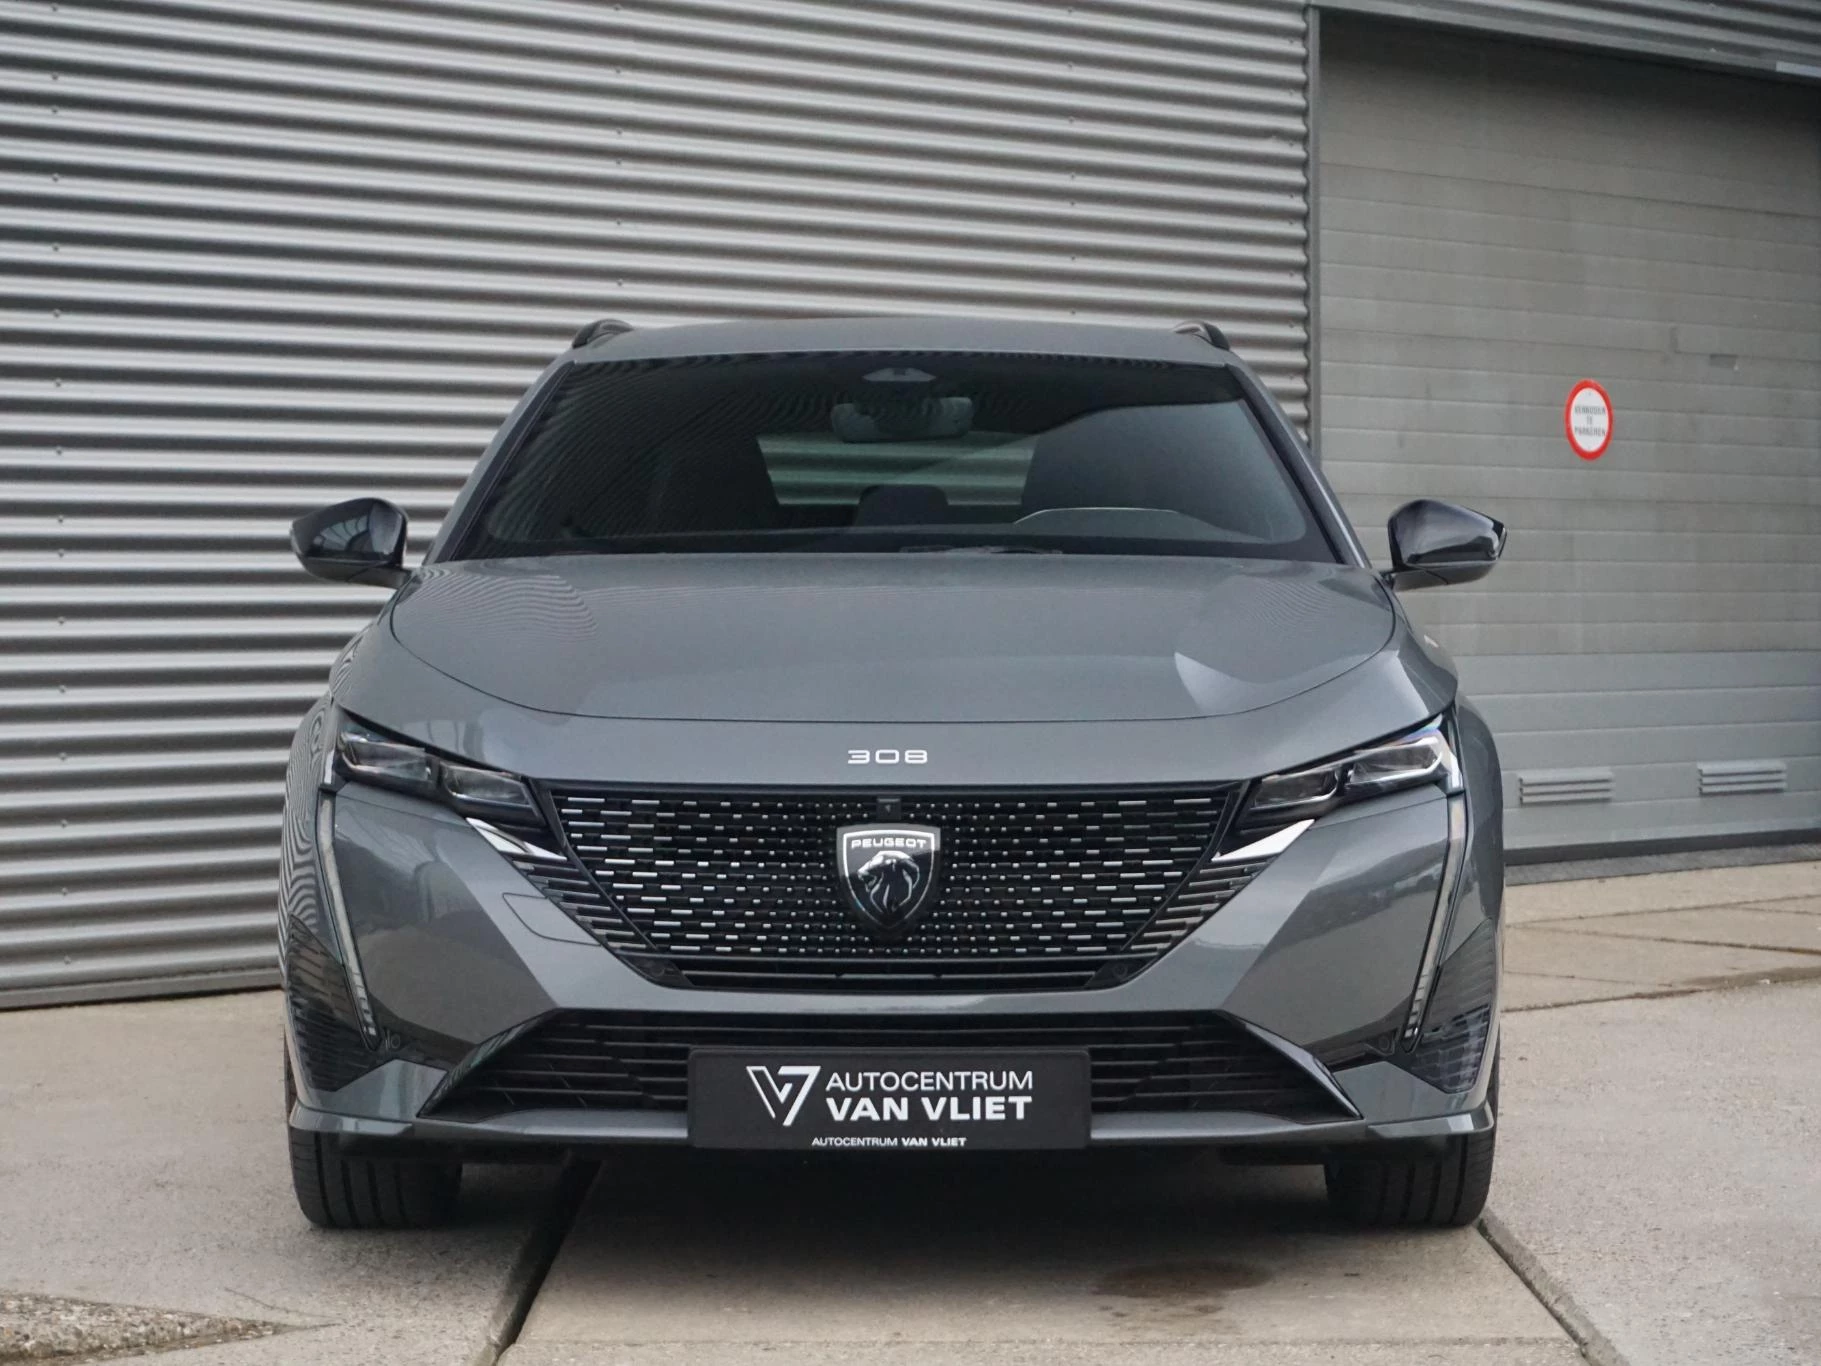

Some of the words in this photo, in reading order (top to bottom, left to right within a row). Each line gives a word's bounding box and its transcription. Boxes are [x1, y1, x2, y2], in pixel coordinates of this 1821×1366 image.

[847, 749, 928, 764] 308
[851, 837, 927, 849] PEUGEOT
[825, 1070, 1033, 1092] AUTOCENTRUM
[825, 1096, 908, 1122] VAN
[921, 1095, 1033, 1121] VLIET
[811, 1136, 899, 1147] AUTOCENTRUM
[901, 1136, 929, 1147] VAN
[931, 1136, 967, 1147] VLIET
